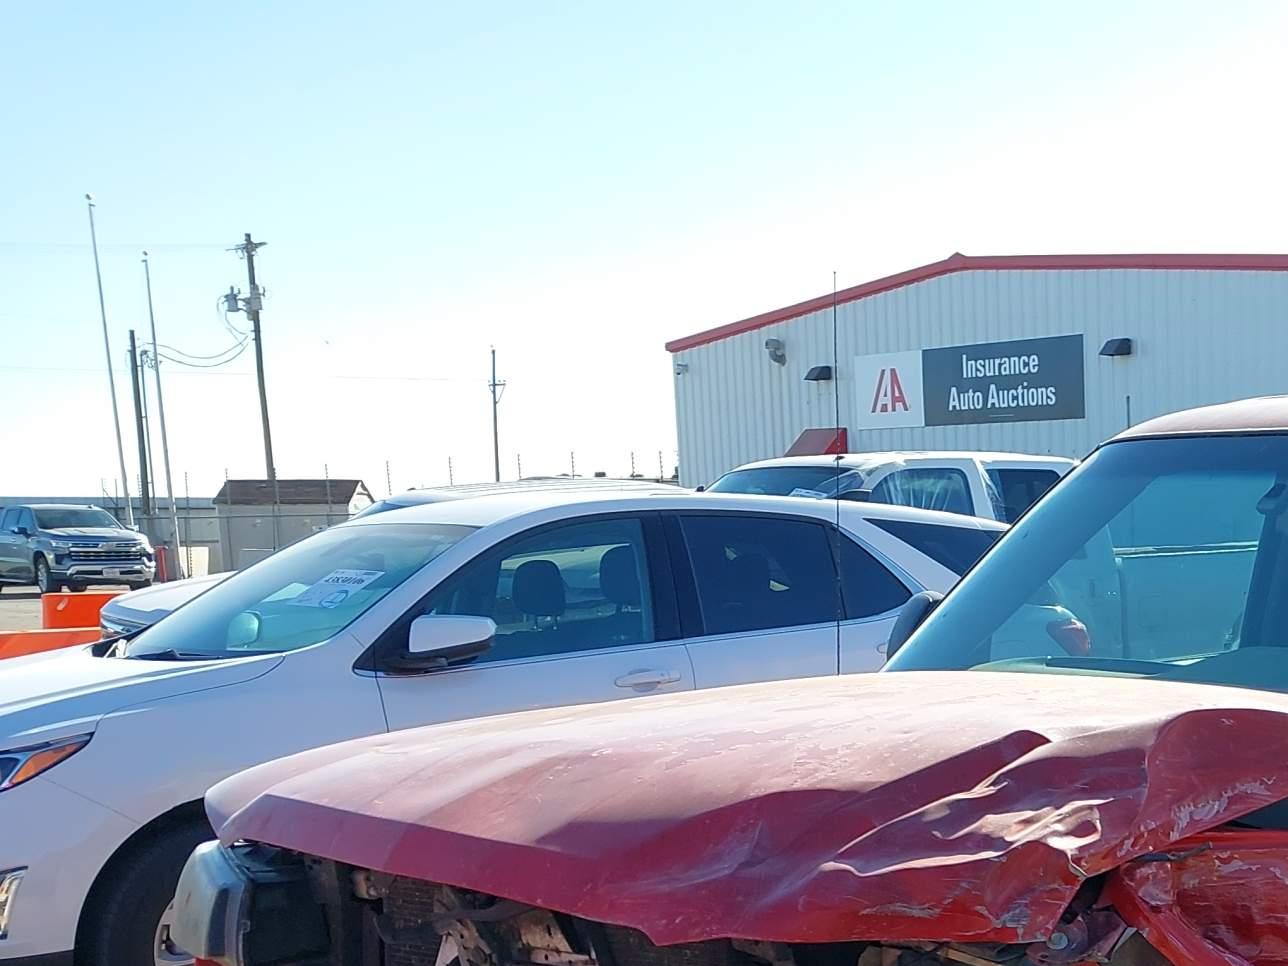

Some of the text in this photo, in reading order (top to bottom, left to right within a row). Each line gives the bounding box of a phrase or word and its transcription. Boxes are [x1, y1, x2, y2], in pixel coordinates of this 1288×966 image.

[962, 354, 1039, 378] Insurance
[949, 381, 1056, 411] Auto Auctions
